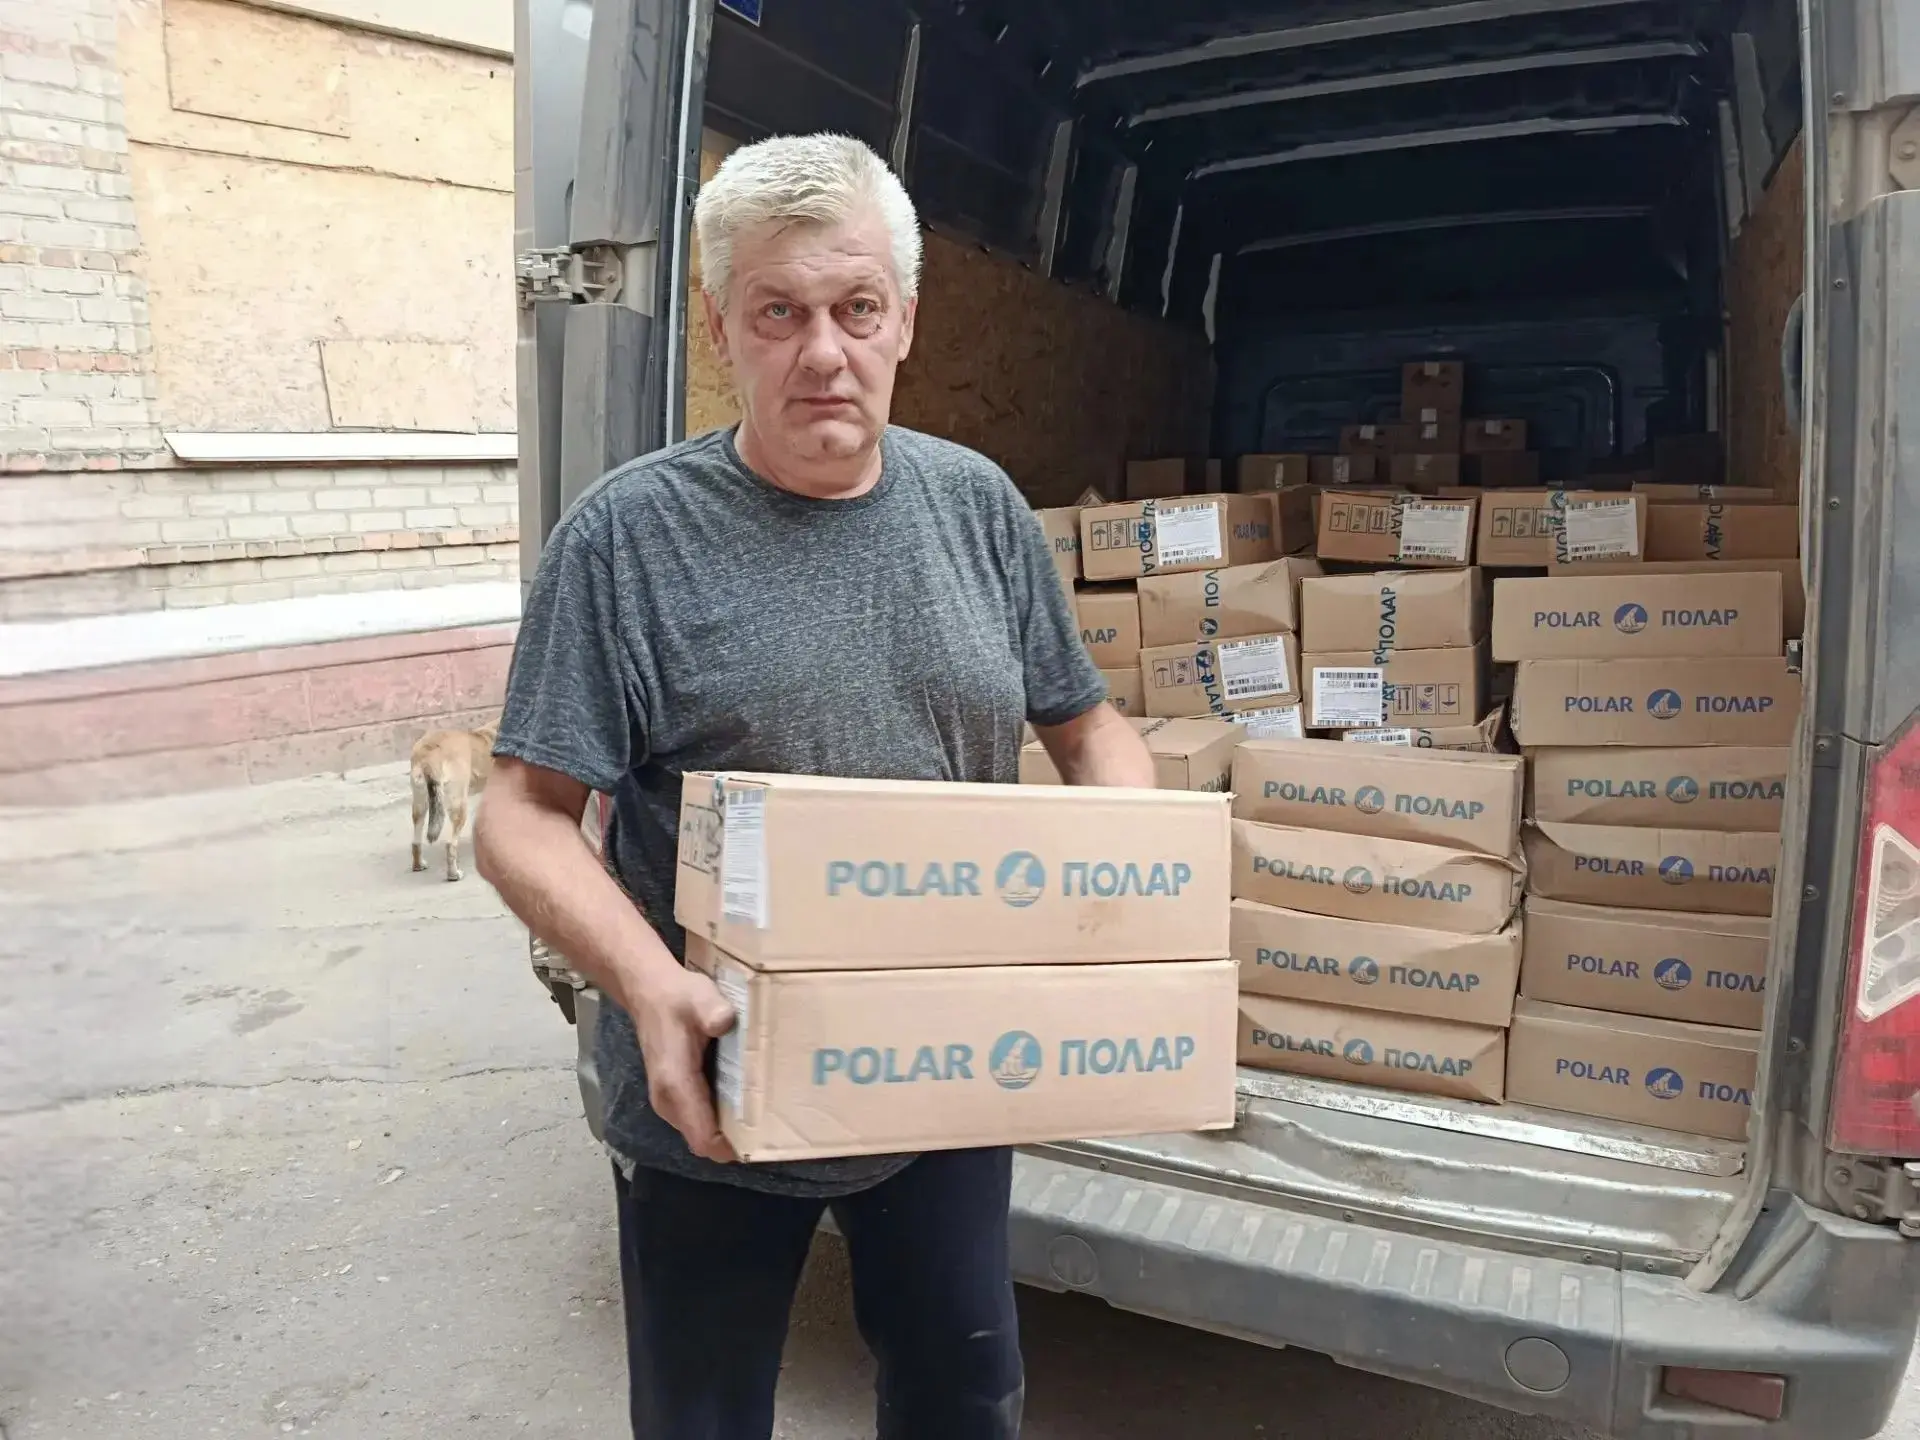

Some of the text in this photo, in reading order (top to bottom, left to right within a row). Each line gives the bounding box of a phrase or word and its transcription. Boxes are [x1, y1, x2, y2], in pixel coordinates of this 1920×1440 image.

[1204, 570, 1219, 607] ПОЛ
[1080, 628, 1117, 643] ЛАР
[1379, 587, 1396, 652] ПОЛАР
[1534, 609, 1738, 628] POLAR ПОЛАР
[1564, 696, 1773, 713] POLAR ПОЛАР
[1264, 781, 1484, 820] POLAR ПОЛАР
[1567, 779, 1785, 800] POLAR ПОЛА
[825, 860, 1191, 898] POLAR ПОЛАР
[1253, 856, 1471, 902] POLAR ПОЛАР
[1574, 856, 1776, 885] POLAR ПОЛА
[1256, 948, 1480, 992] POLAR ПОЛАР
[1567, 954, 1766, 993] POLAR ПОЛА
[812, 1035, 1195, 1086] POLAR ПОЛАР
[1252, 1029, 1472, 1077] POLAR ПОЛАР
[1556, 1059, 1751, 1105] POLAR ПОЛ
